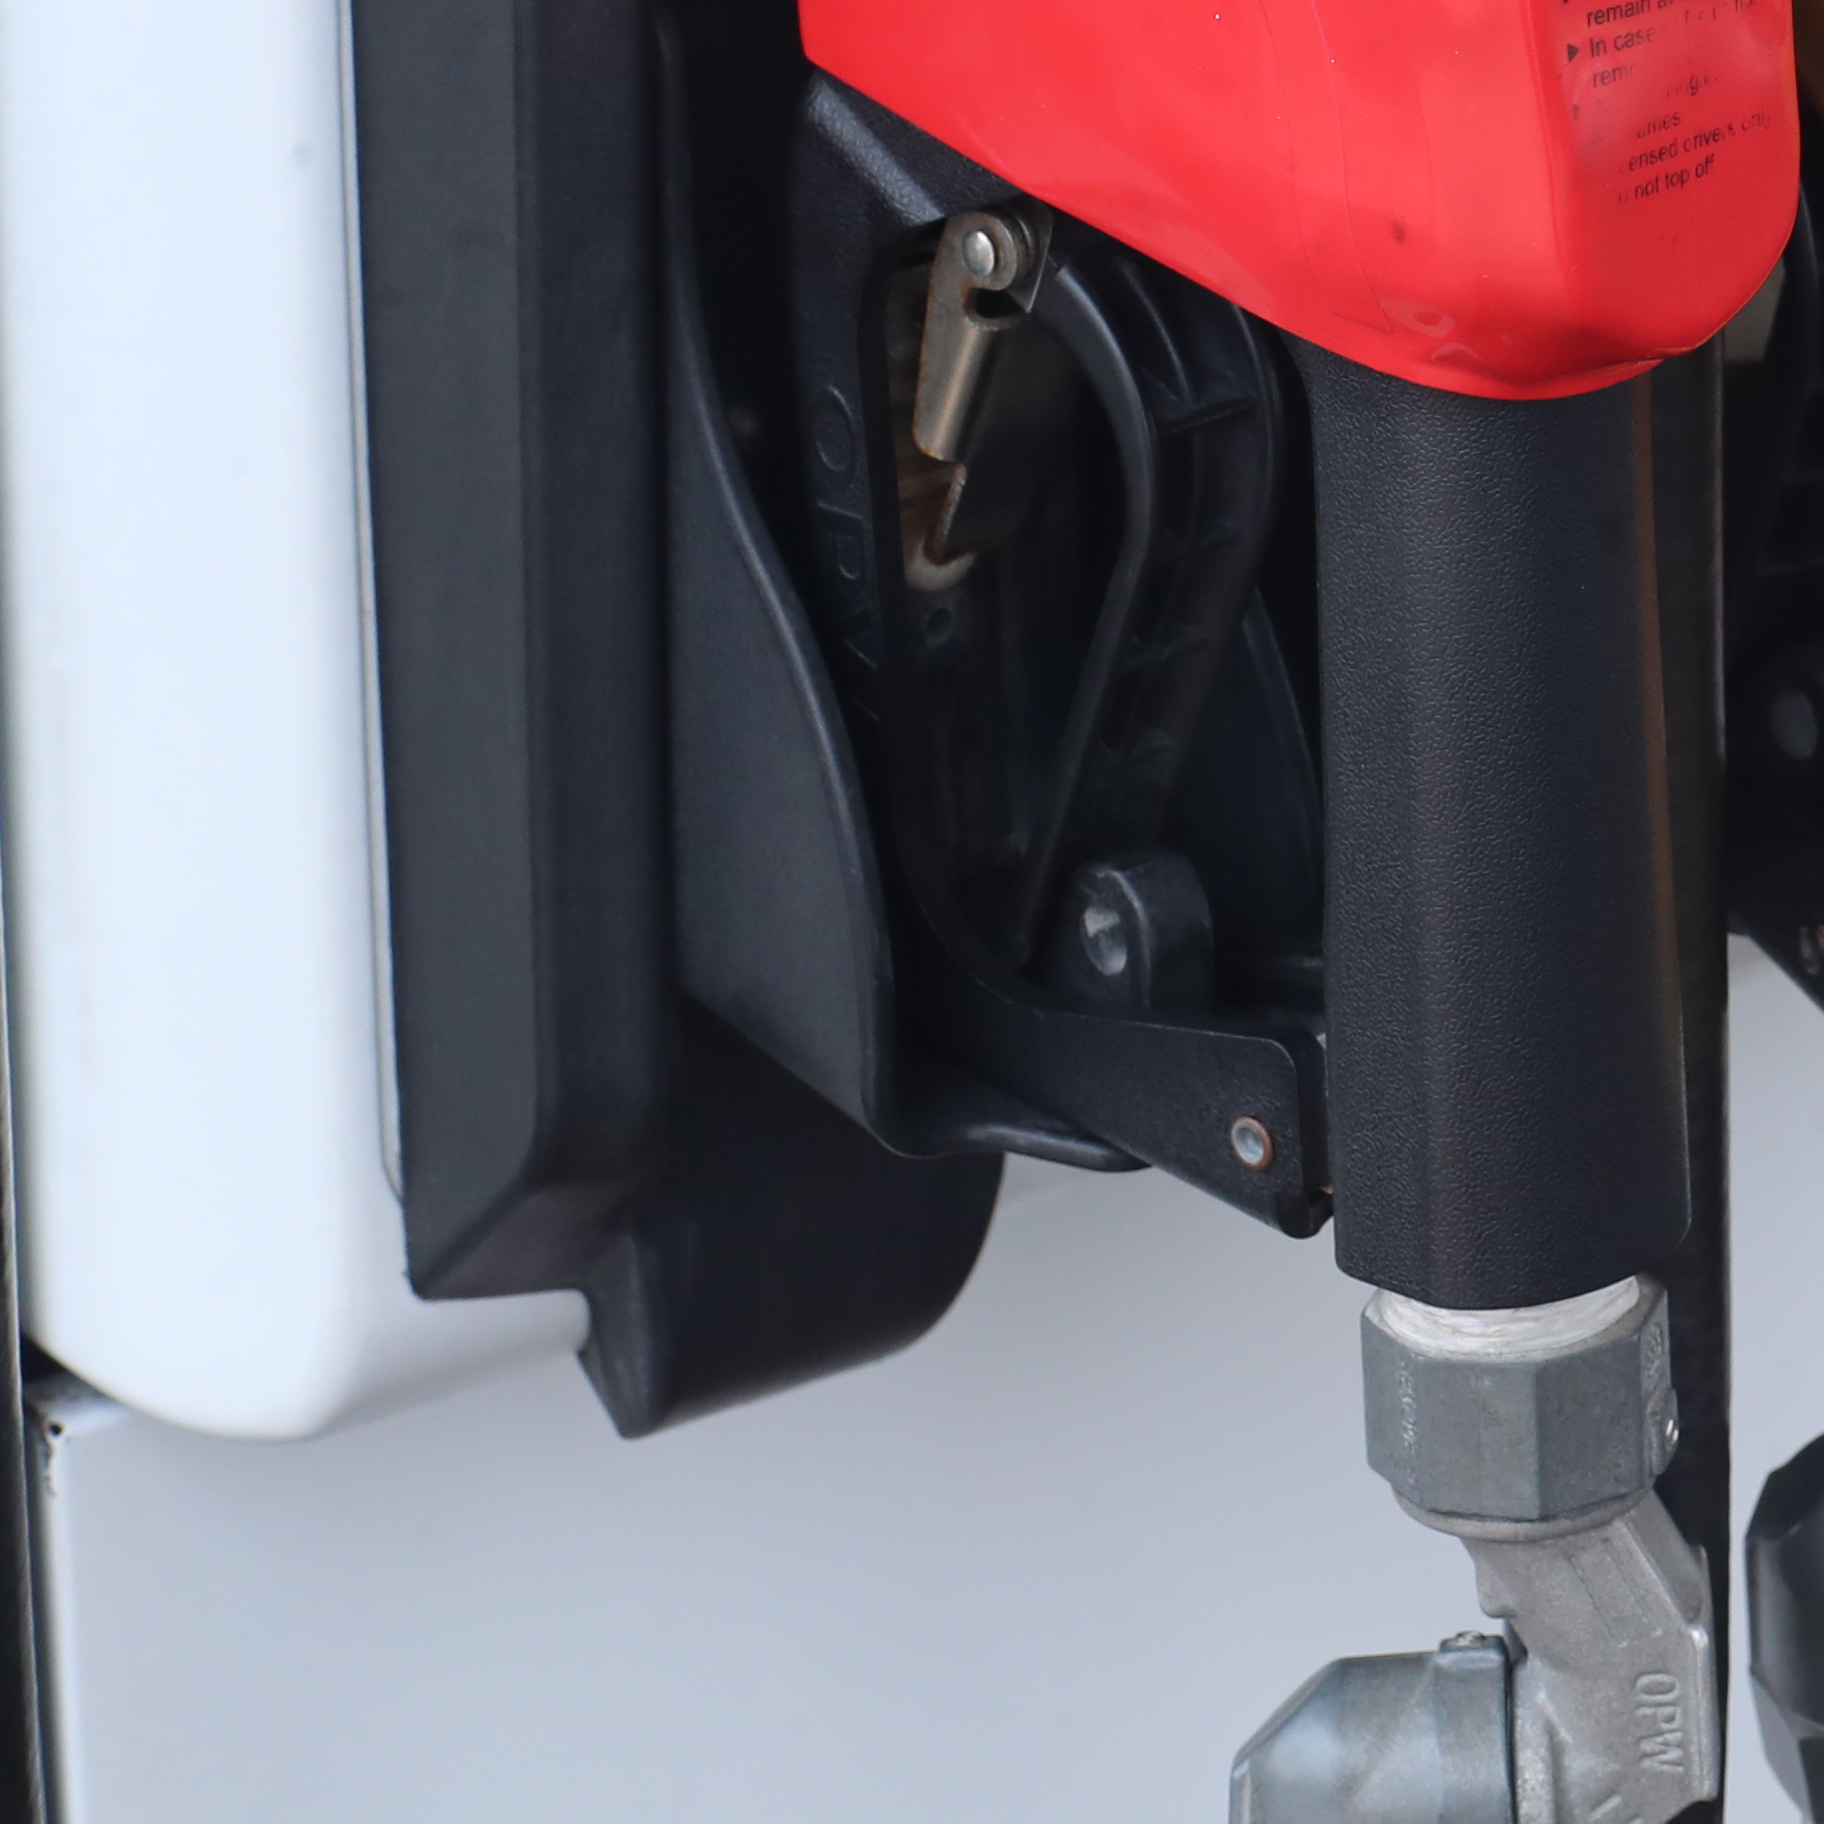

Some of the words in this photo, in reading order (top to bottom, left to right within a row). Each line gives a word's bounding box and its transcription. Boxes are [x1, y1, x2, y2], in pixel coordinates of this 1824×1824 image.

[1590, 37, 1607, 58] In
[1613, 27, 1656, 52] case
[1634, 172, 1661, 200] not
[1664, 169, 1690, 190] top
[1695, 152, 1716, 178] off
[1634, 1672, 1685, 1775] OPW
